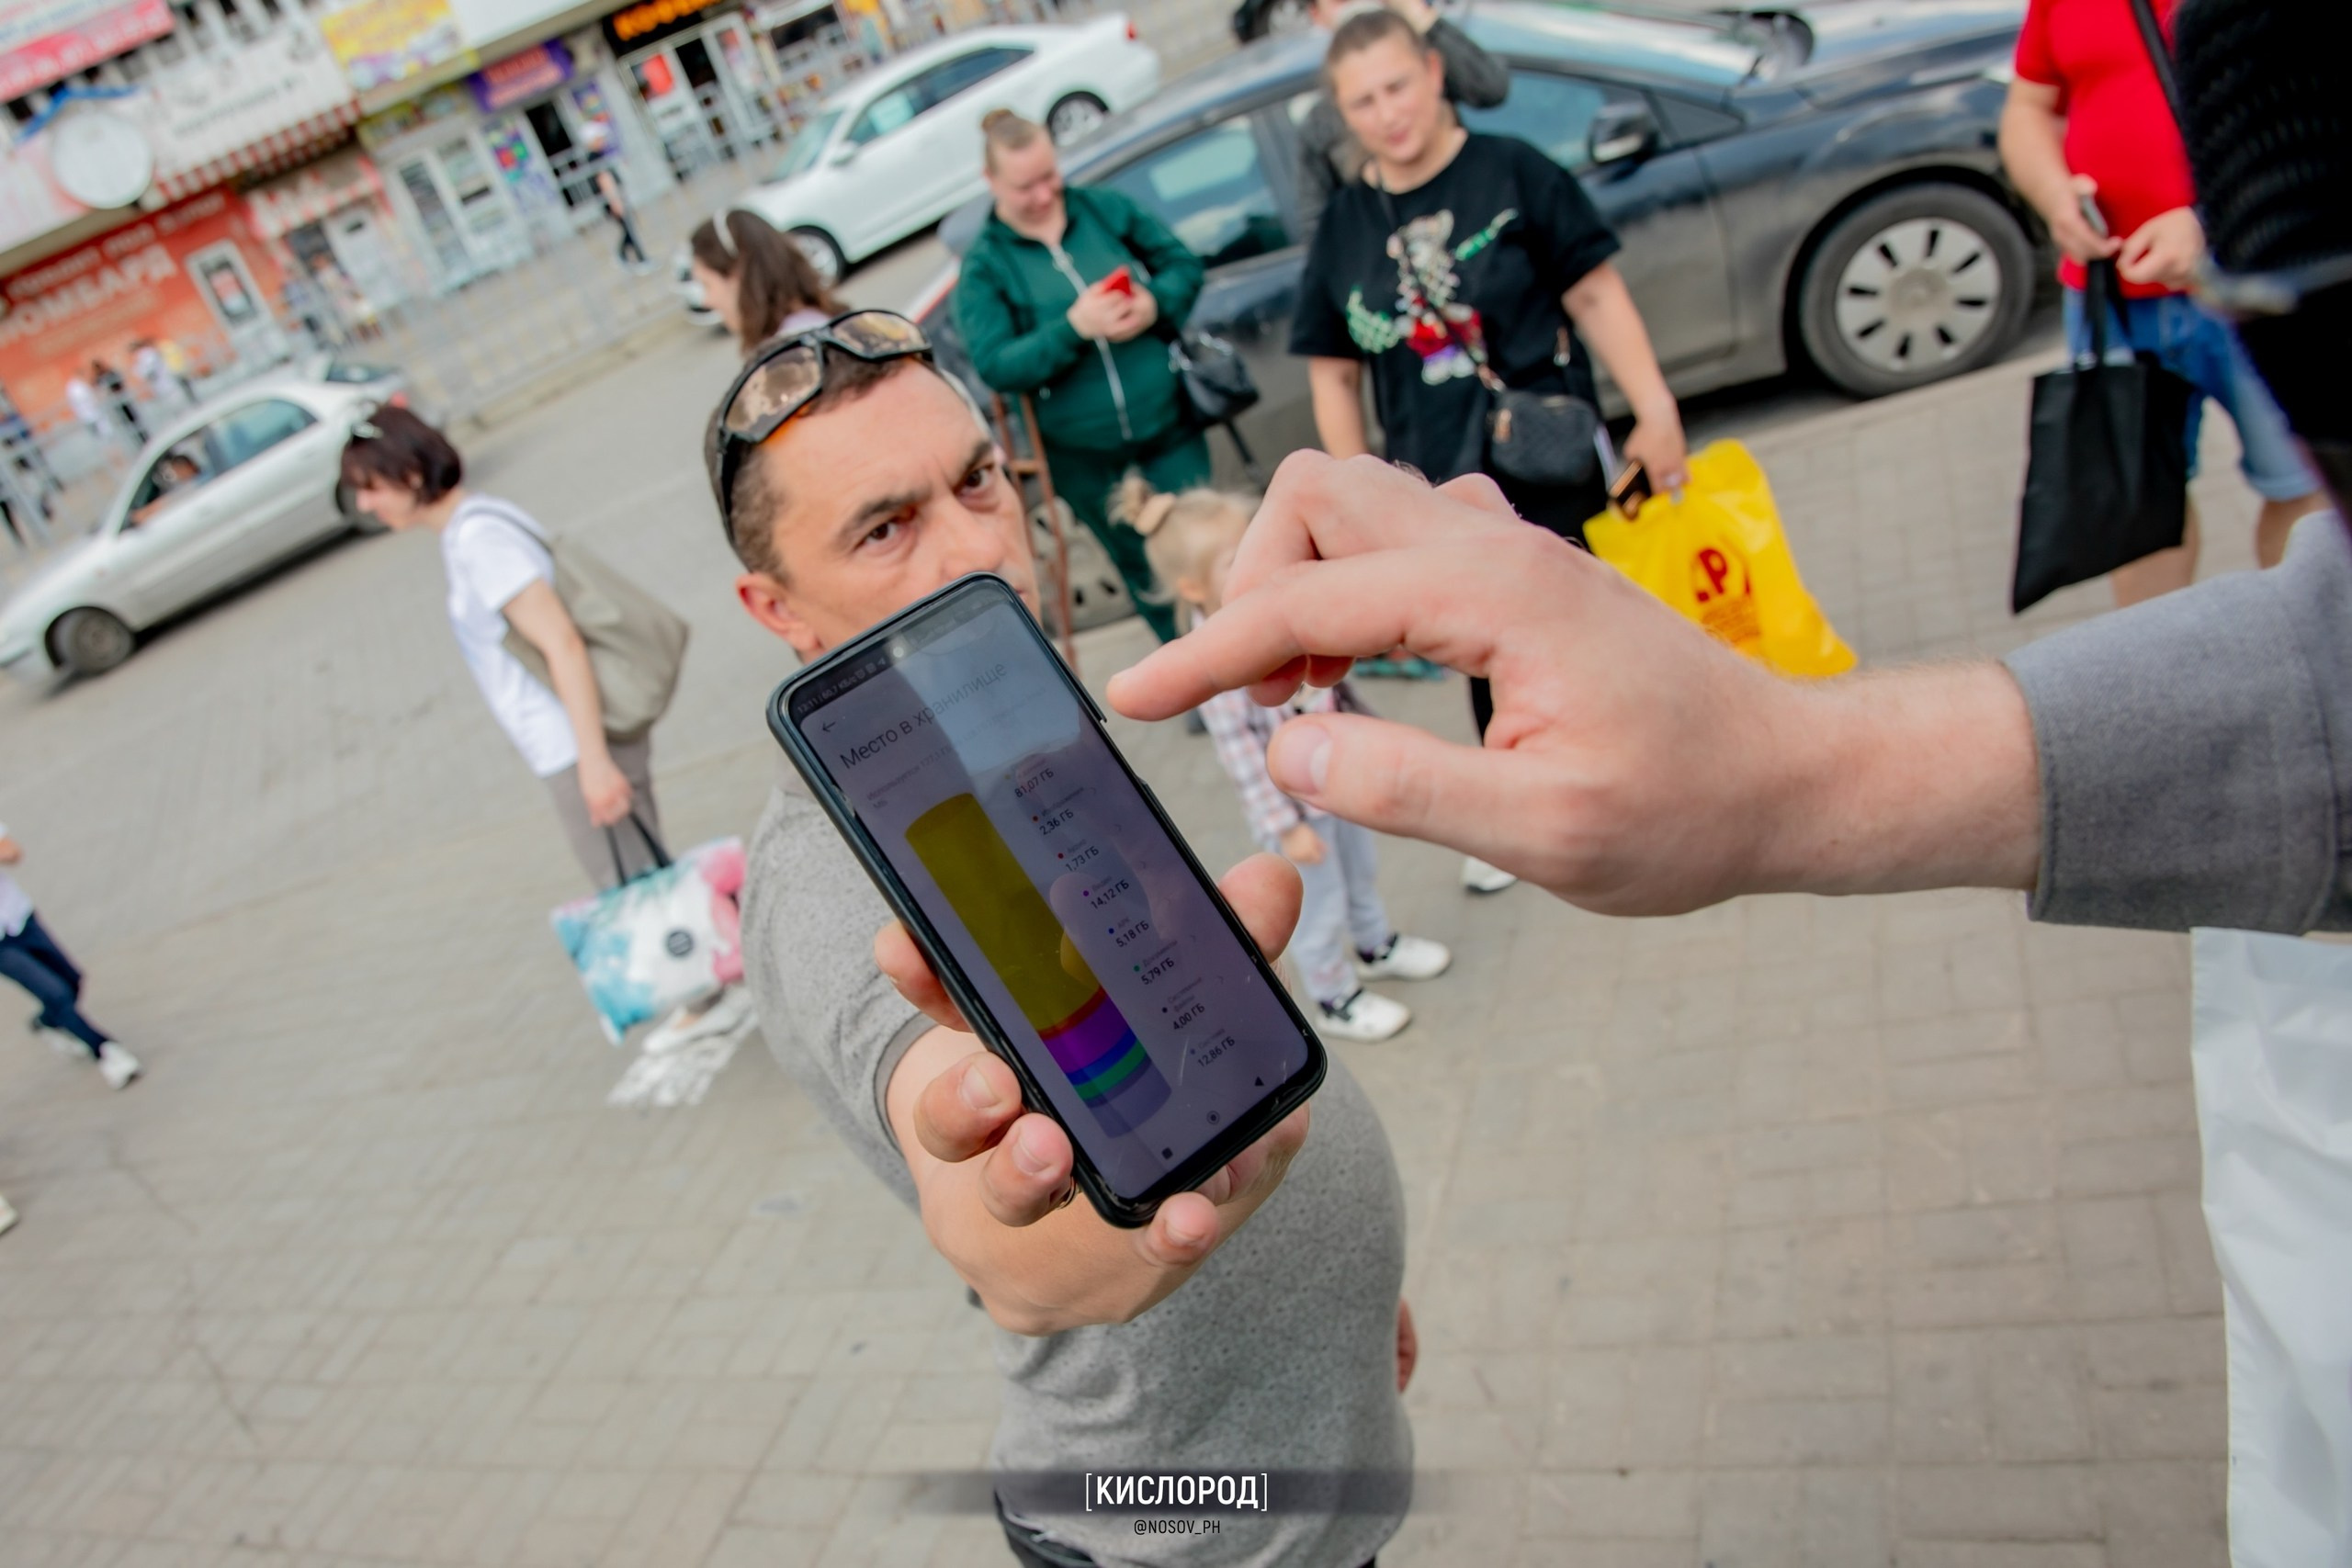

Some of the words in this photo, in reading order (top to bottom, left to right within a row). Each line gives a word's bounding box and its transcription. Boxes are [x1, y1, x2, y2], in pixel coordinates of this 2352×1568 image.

[839, 729, 899, 770] Место
[899, 720, 913, 735] в
[911, 662, 1007, 726] хранилище
[1013, 775, 1039, 798] 81,07
[1039, 767, 1055, 782] ГБ
[1039, 818, 1060, 835] 2,36
[1059, 808, 1074, 822] ГБ
[1065, 854, 1086, 872] 1,73
[1084, 845, 1100, 860] ГБ
[1091, 888, 1117, 909] 14,12
[1114, 879, 1130, 893] ГБ
[1115, 929, 1136, 948] 5,18
[1135, 919, 1149, 934] ГБ
[1140, 966, 1161, 985] 5,79
[1159, 957, 1175, 972] ГБ
[1172, 1011, 1193, 1030] 4,00
[1190, 1002, 1205, 1017] ГБ
[1197, 1045, 1223, 1067] 12,86
[1220, 1035, 1236, 1052] ГБ
